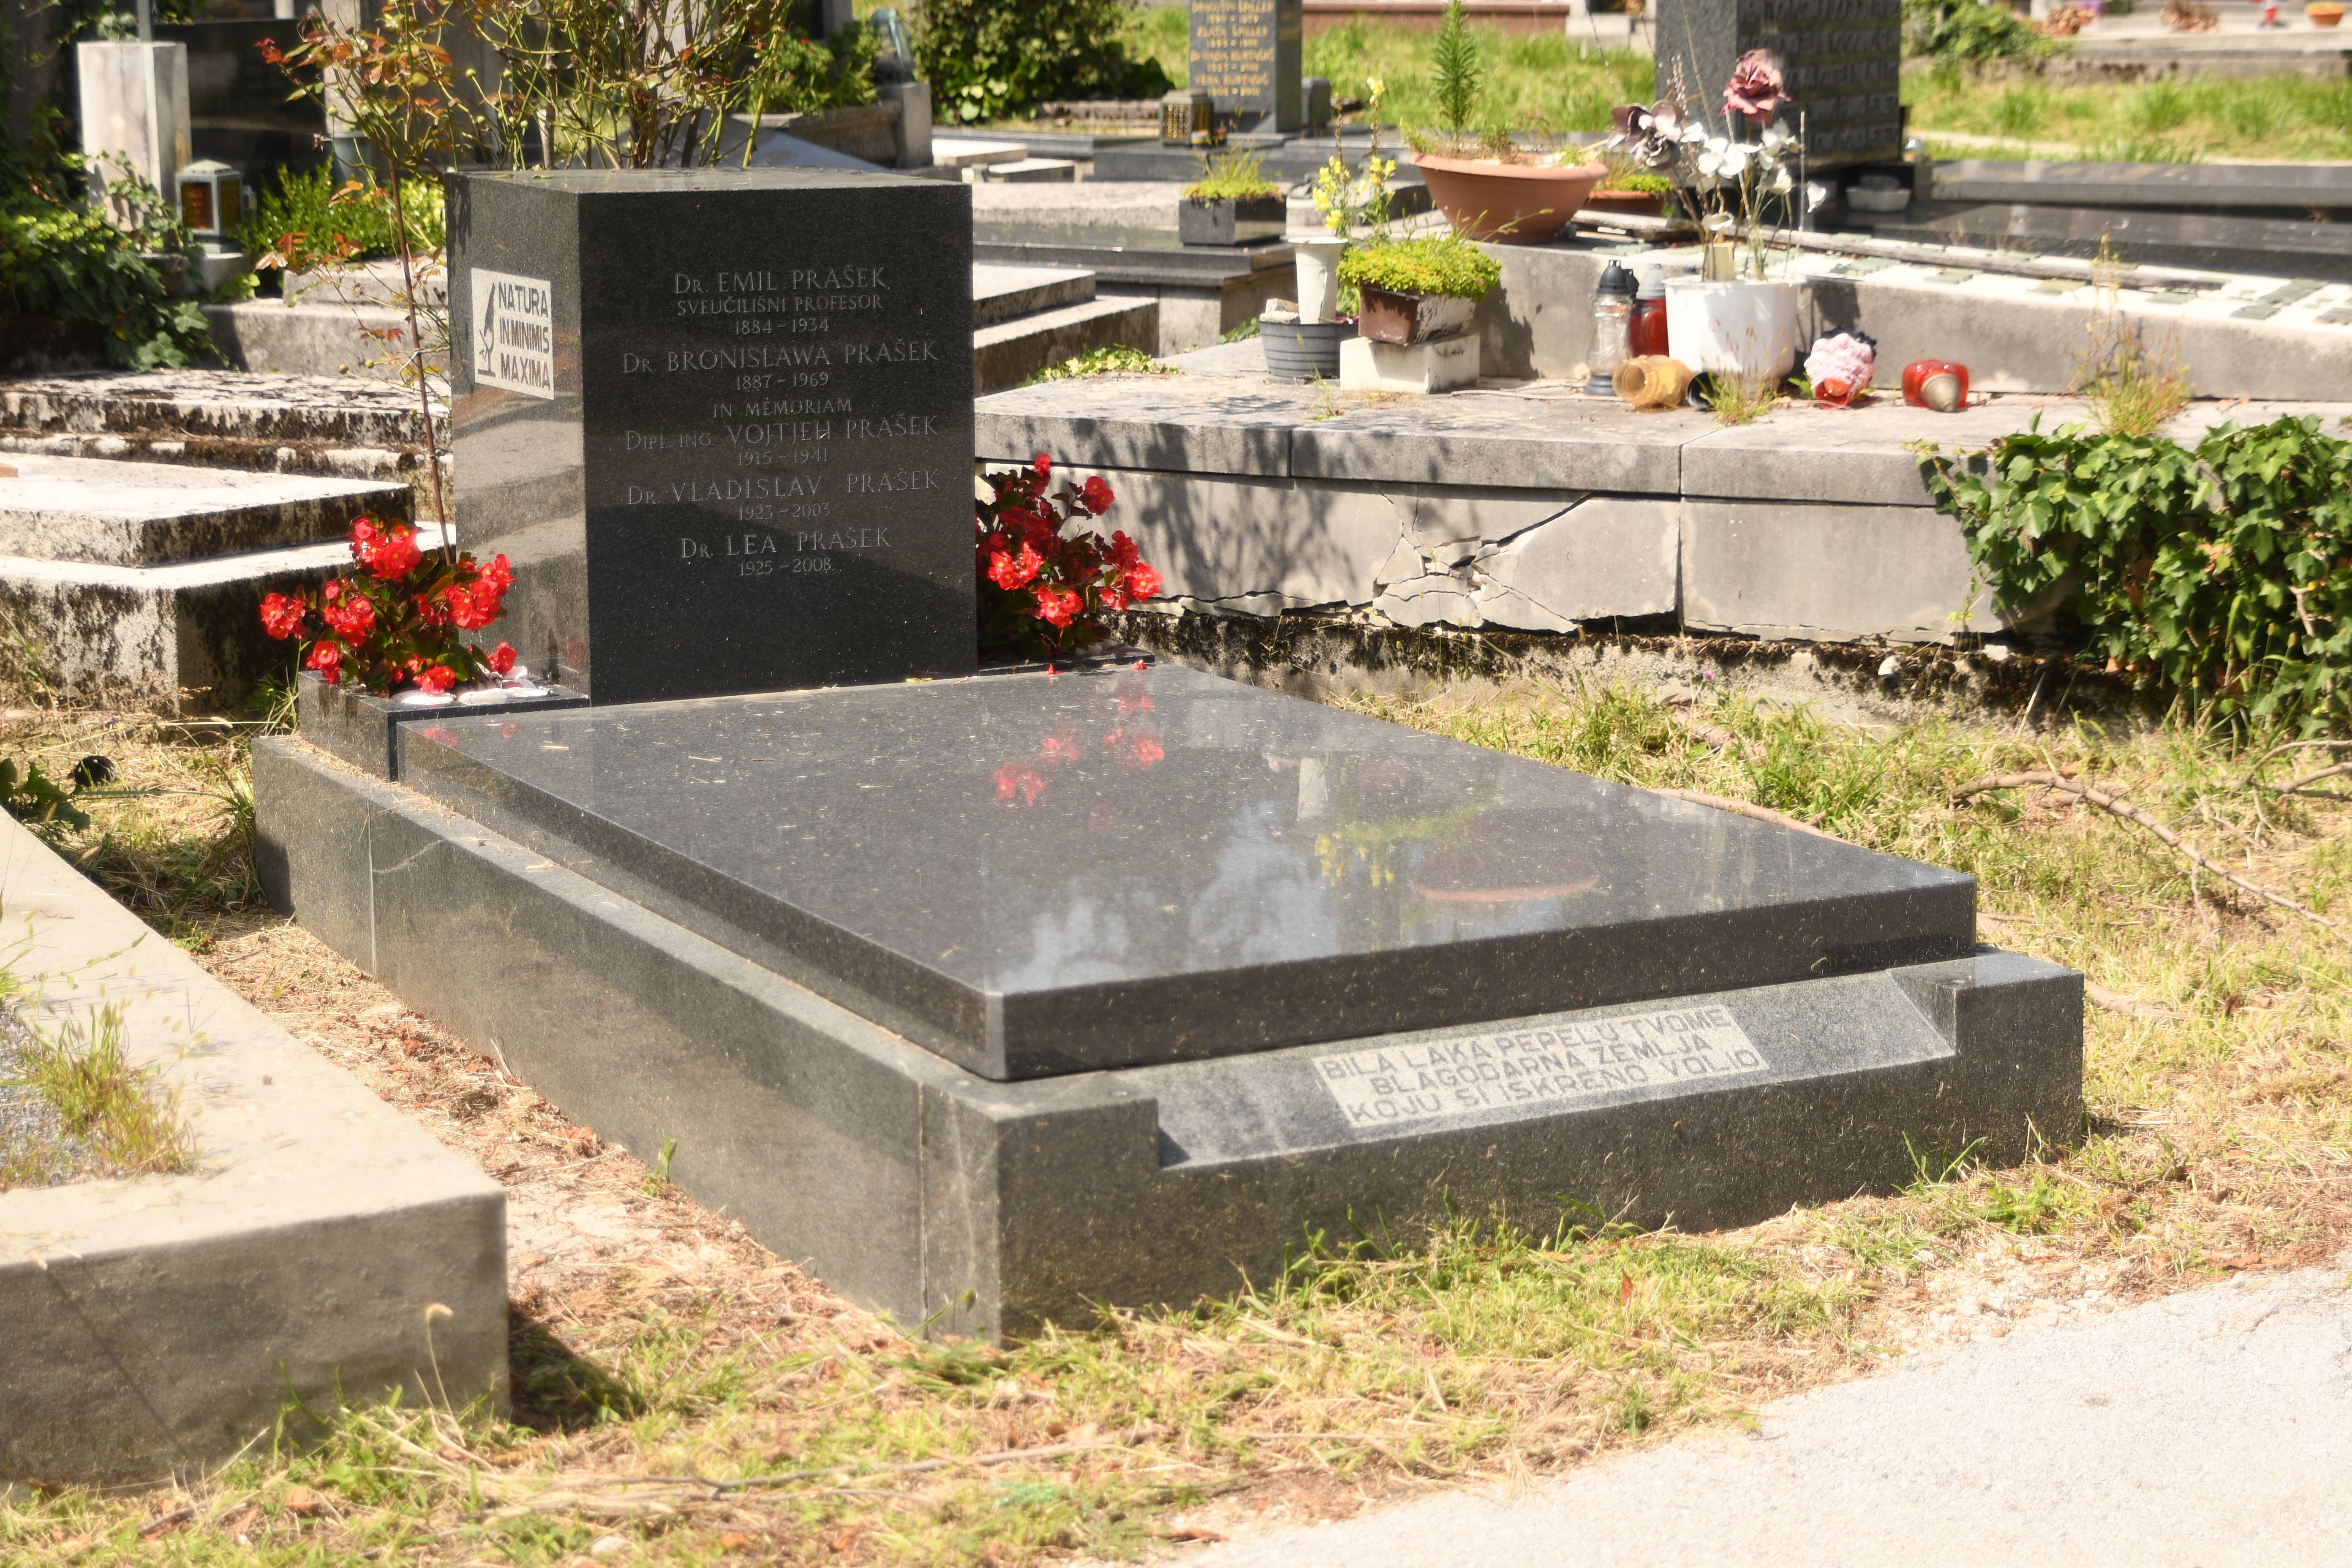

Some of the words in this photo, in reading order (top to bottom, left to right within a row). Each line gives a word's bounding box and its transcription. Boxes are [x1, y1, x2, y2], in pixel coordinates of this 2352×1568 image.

[719, 271, 777, 292] EMIL
[793, 265, 887, 290] PRAŠEK
[498, 282, 549, 318] NATURA
[678, 296, 786, 315] SVEUČILIŠNI
[795, 294, 883, 311] PROFESOR
[500, 317, 510, 345] IN
[511, 319, 550, 354] MINIMIS
[735, 319, 773, 335] 1884
[792, 318, 829, 332] 1934
[667, 345, 830, 371] BRONISLAWA
[845, 338, 939, 363] PRAŠEK
[501, 352, 551, 390] MAXIMA
[736, 374, 772, 390] 1887
[792, 372, 828, 387] 1969
[713, 403, 732, 418] IN
[746, 399, 851, 416] MEMORIAM
[725, 420, 832, 447] VOJTJEH
[846, 413, 937, 439] PRAŠEK
[738, 451, 772, 466] 1915
[793, 448, 828, 463] 1941
[672, 475, 821, 502] VLADISLAV
[847, 467, 940, 493] PRAŠEK
[738, 505, 773, 520] 1923
[792, 503, 830, 517] 2003
[726, 534, 777, 555] LEA
[797, 526, 891, 551] PRAŠEK
[738, 561, 773, 576] 1925
[793, 557, 831, 573] 2008
[1321, 1053, 1397, 1080] BILA
[1399, 1040, 1493, 1069] LAKA
[1493, 1021, 1620, 1057] PEPELU
[1621, 1008, 1731, 1039] TVOME
[1370, 1050, 1587, 1096] BLAGODARNA
[1590, 1033, 1713, 1066] ZEMLJA
[1346, 1092, 1443, 1124] KOJU
[1454, 1086, 1490, 1108] SI
[1498, 1063, 1648, 1102] ISKRENO
[1660, 1049, 1760, 1078] VOLIO
